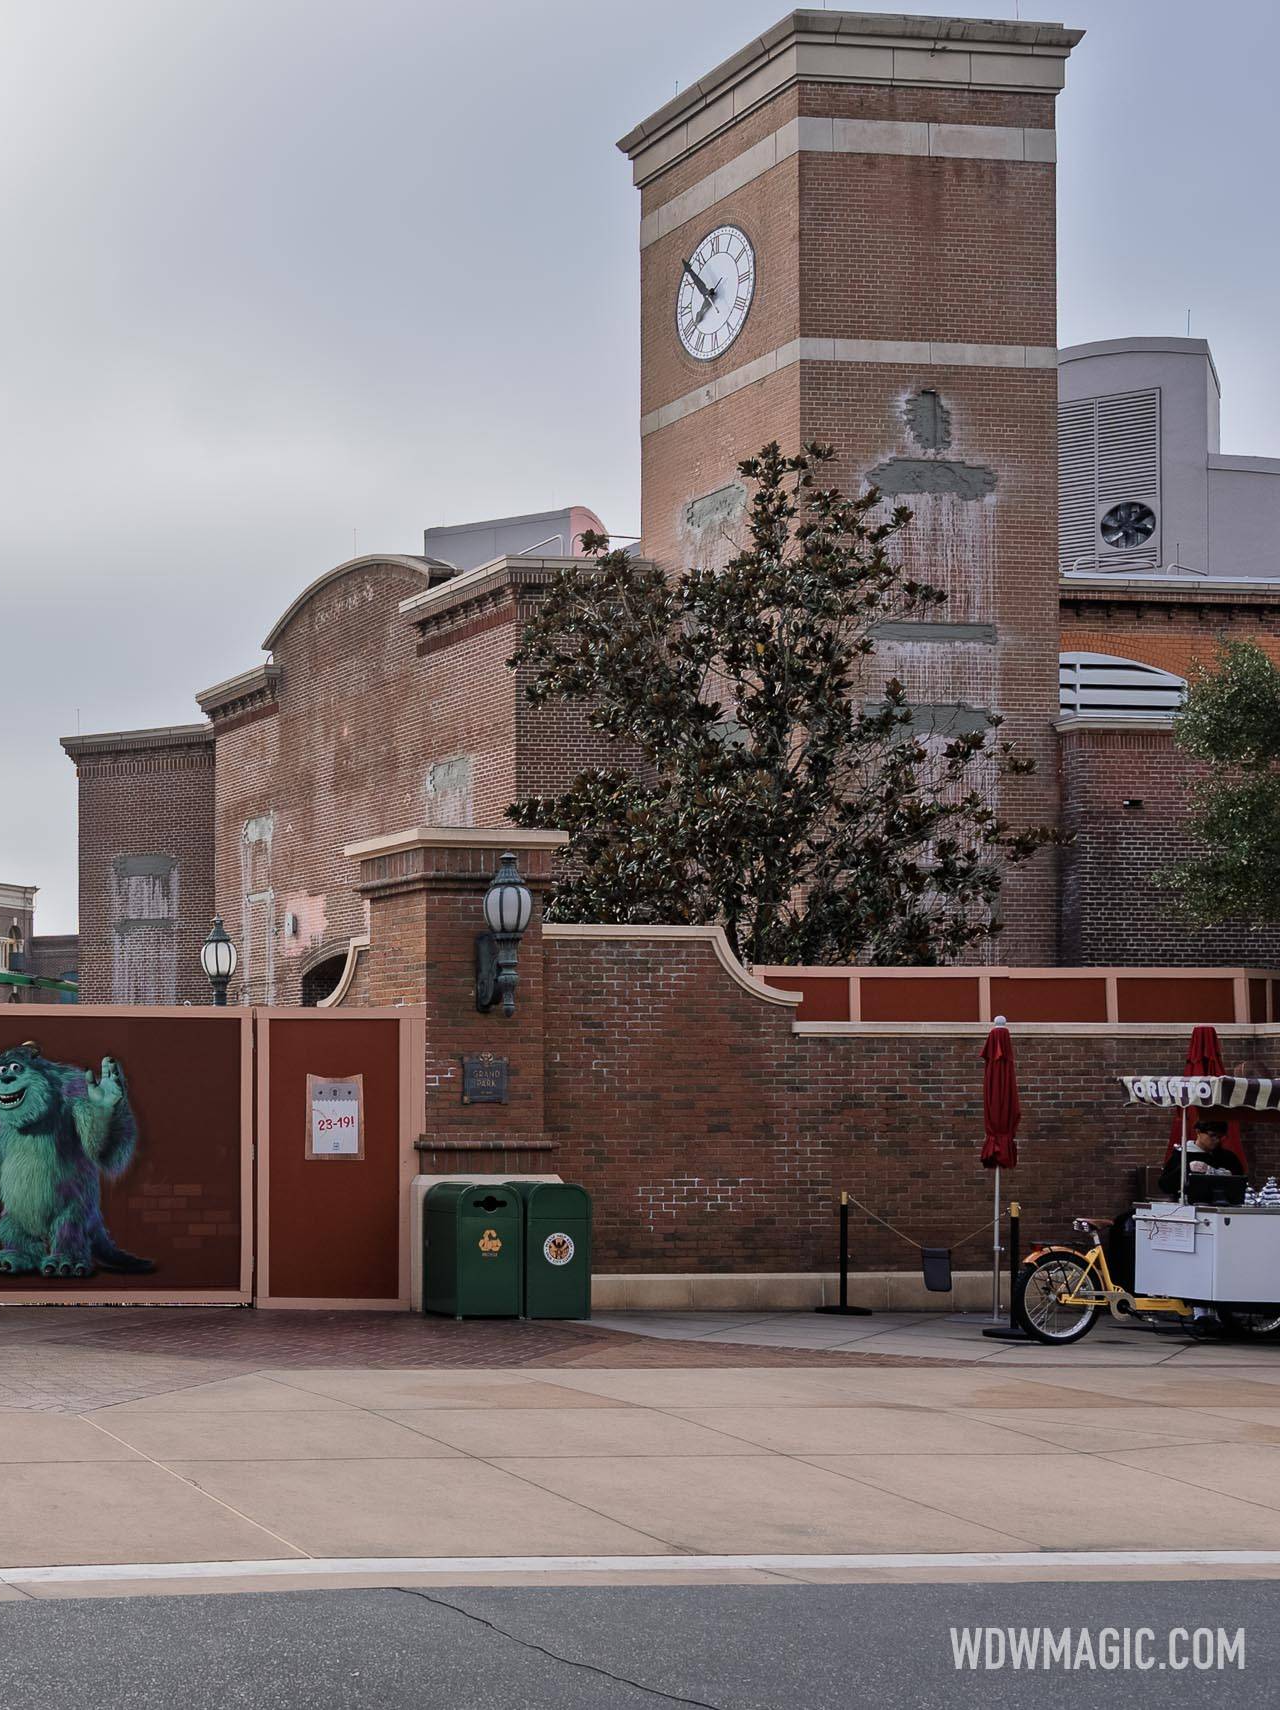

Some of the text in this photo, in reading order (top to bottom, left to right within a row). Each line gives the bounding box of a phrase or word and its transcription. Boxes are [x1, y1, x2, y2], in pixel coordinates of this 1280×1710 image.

[735, 247, 746, 263] II
[738, 270, 751, 284] III
[318, 1116, 355, 1131] 23-19!
